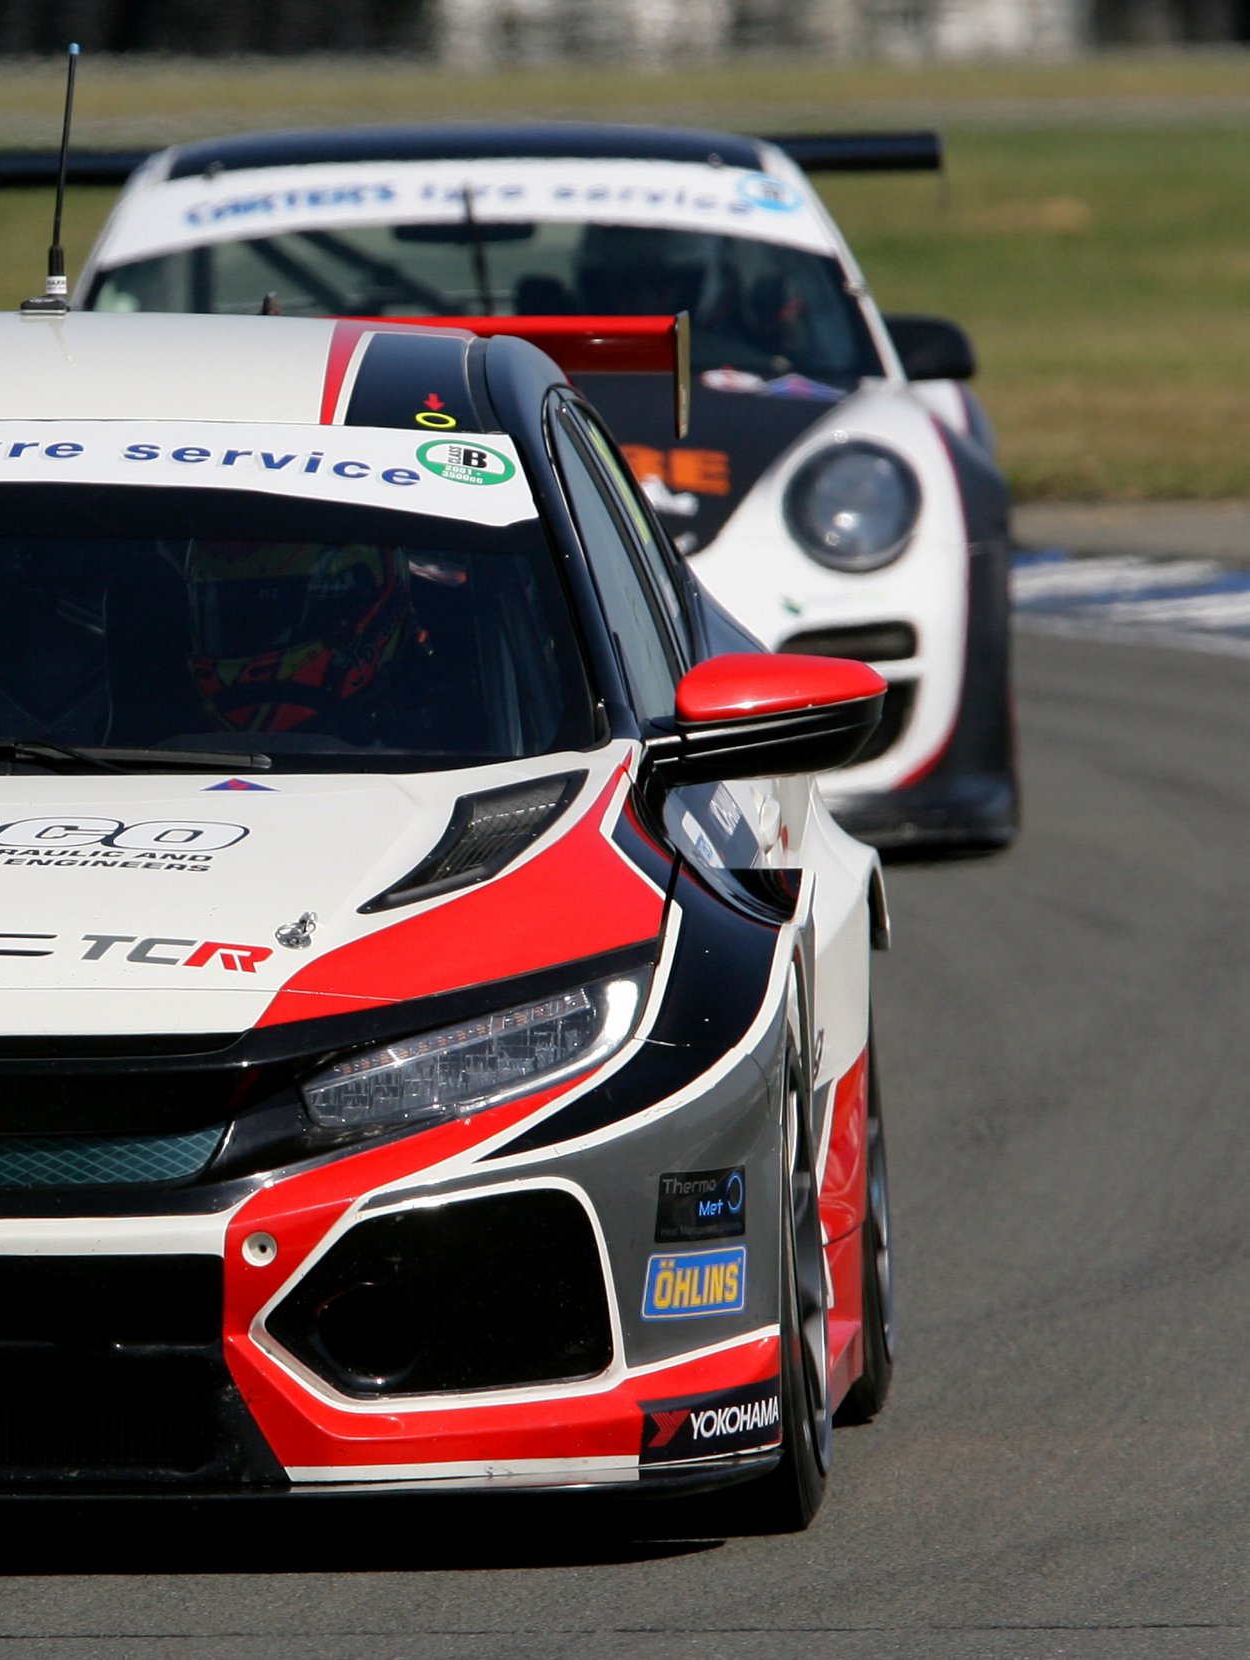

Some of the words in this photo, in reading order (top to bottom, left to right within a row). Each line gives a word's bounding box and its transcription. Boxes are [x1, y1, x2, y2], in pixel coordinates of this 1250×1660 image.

[124, 441, 421, 486] service
[463, 448, 487, 468] B
[3, 858, 212, 872] ENGINEERS
[133, 852, 214, 862] AND
[80, 934, 274, 974] TCR
[661, 1177, 717, 1196] Thermo
[698, 1199, 724, 1217] Met
[653, 1258, 738, 1310] ÖHLINS
[690, 1396, 779, 1440] YOKOHAMA
